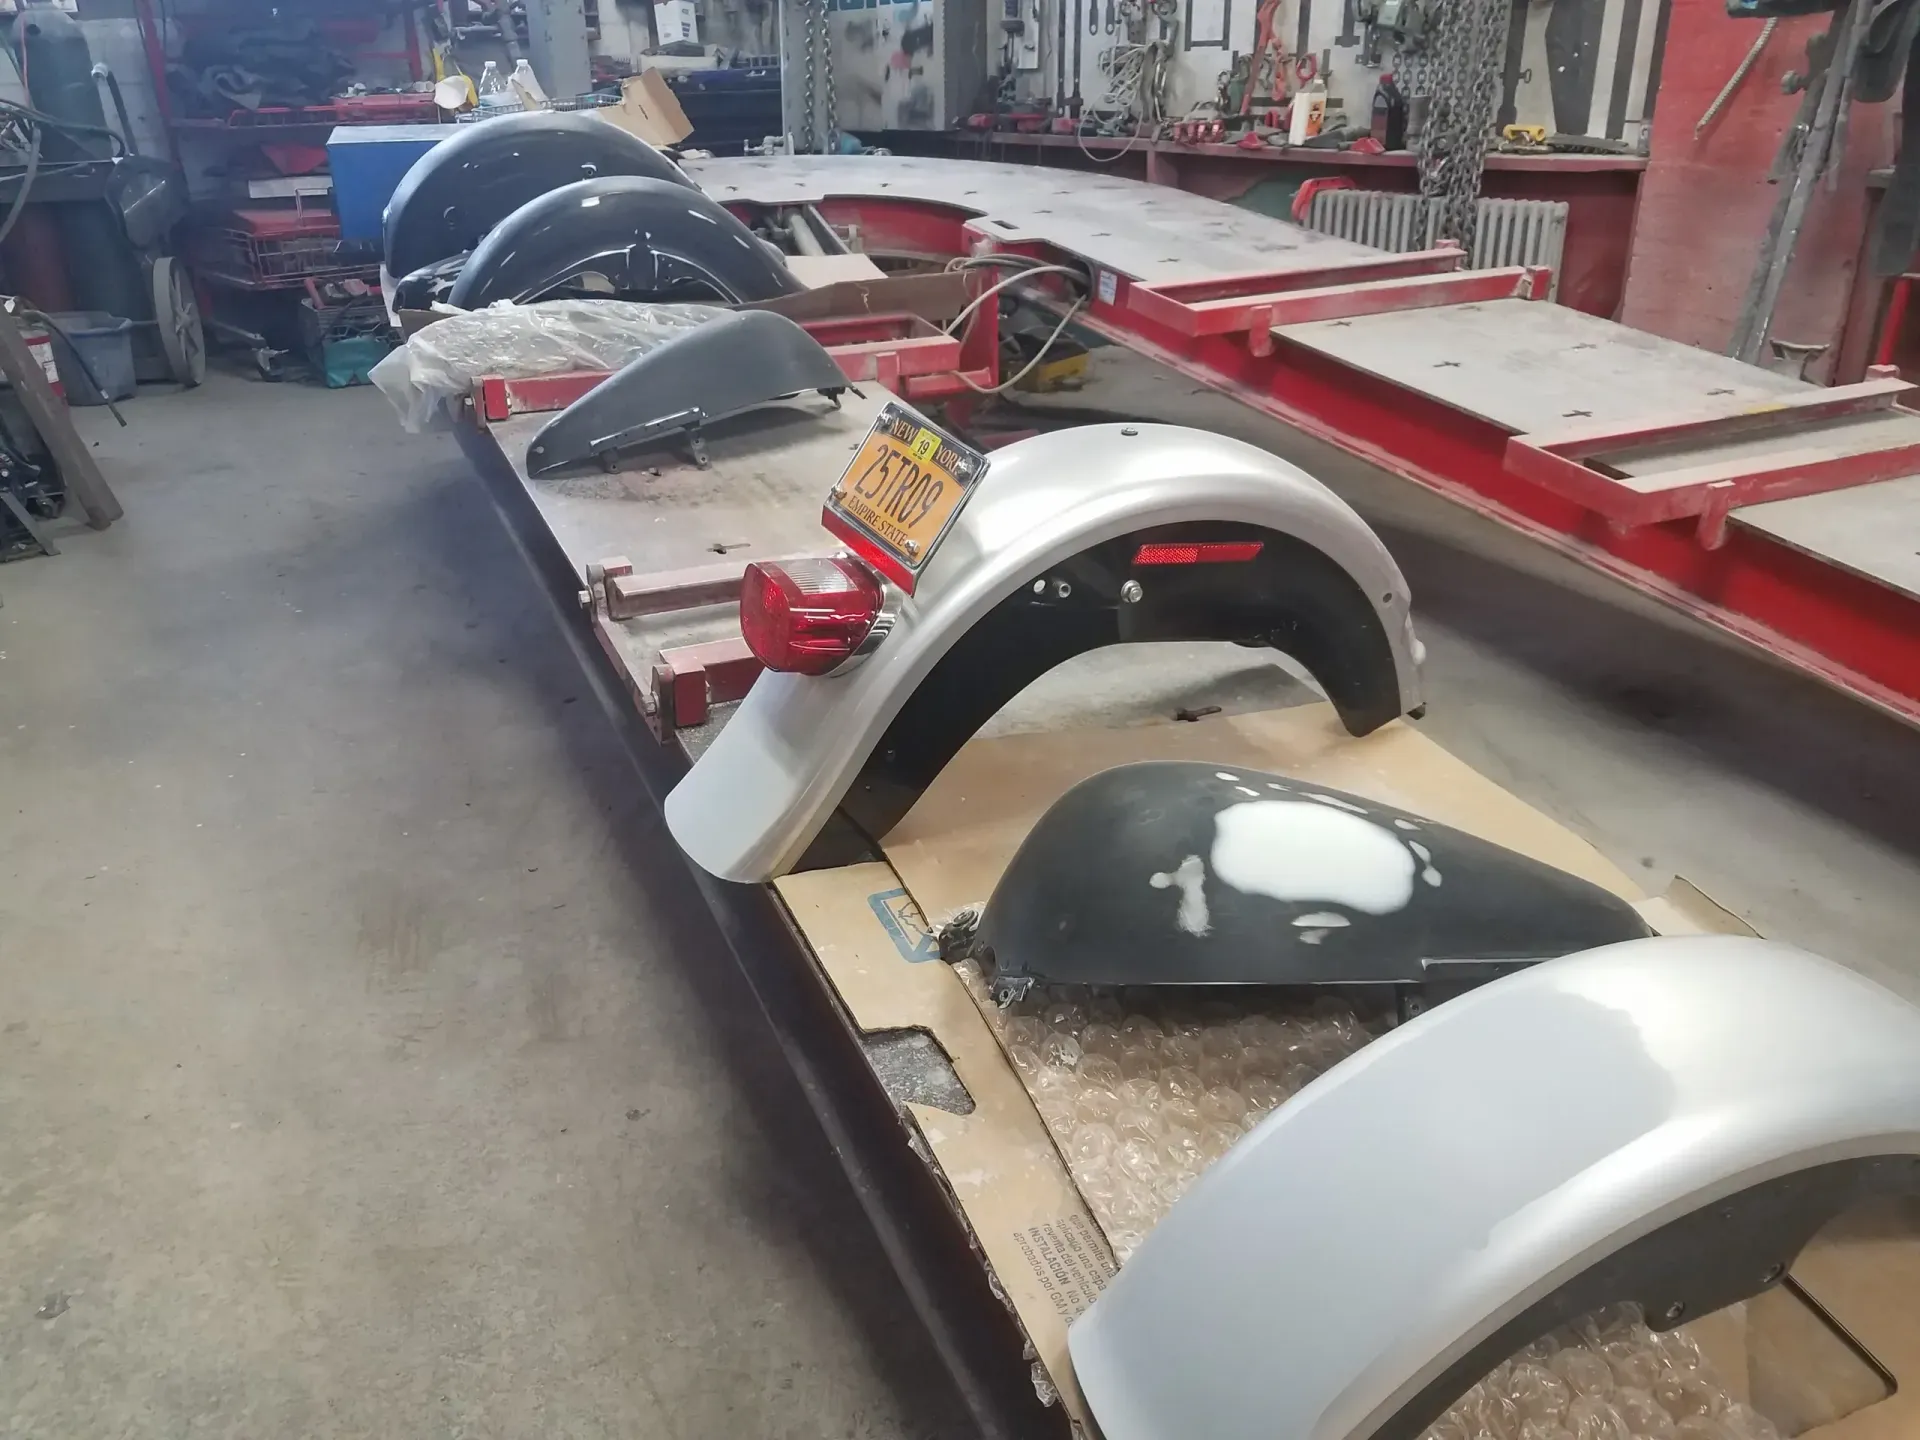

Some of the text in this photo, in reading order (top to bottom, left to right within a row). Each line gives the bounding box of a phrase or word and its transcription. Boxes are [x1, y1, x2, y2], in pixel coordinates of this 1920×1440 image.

[891, 418, 918, 444] NEW
[917, 440, 930, 455] 19
[854, 444, 944, 529] 25TR09
[847, 495, 908, 547] EMPIRE STATE
[1013, 1232, 1046, 1277] aprobados
[1038, 1276, 1055, 1292] por
[1028, 1227, 1071, 1286] INSTALACIÓN
[1067, 1290, 1080, 1304] No
[1061, 1253, 1077, 1267] del
[1080, 1229, 1105, 1262] permite
[1100, 1261, 1117, 1279] una
[1088, 1269, 1107, 1291] capa
